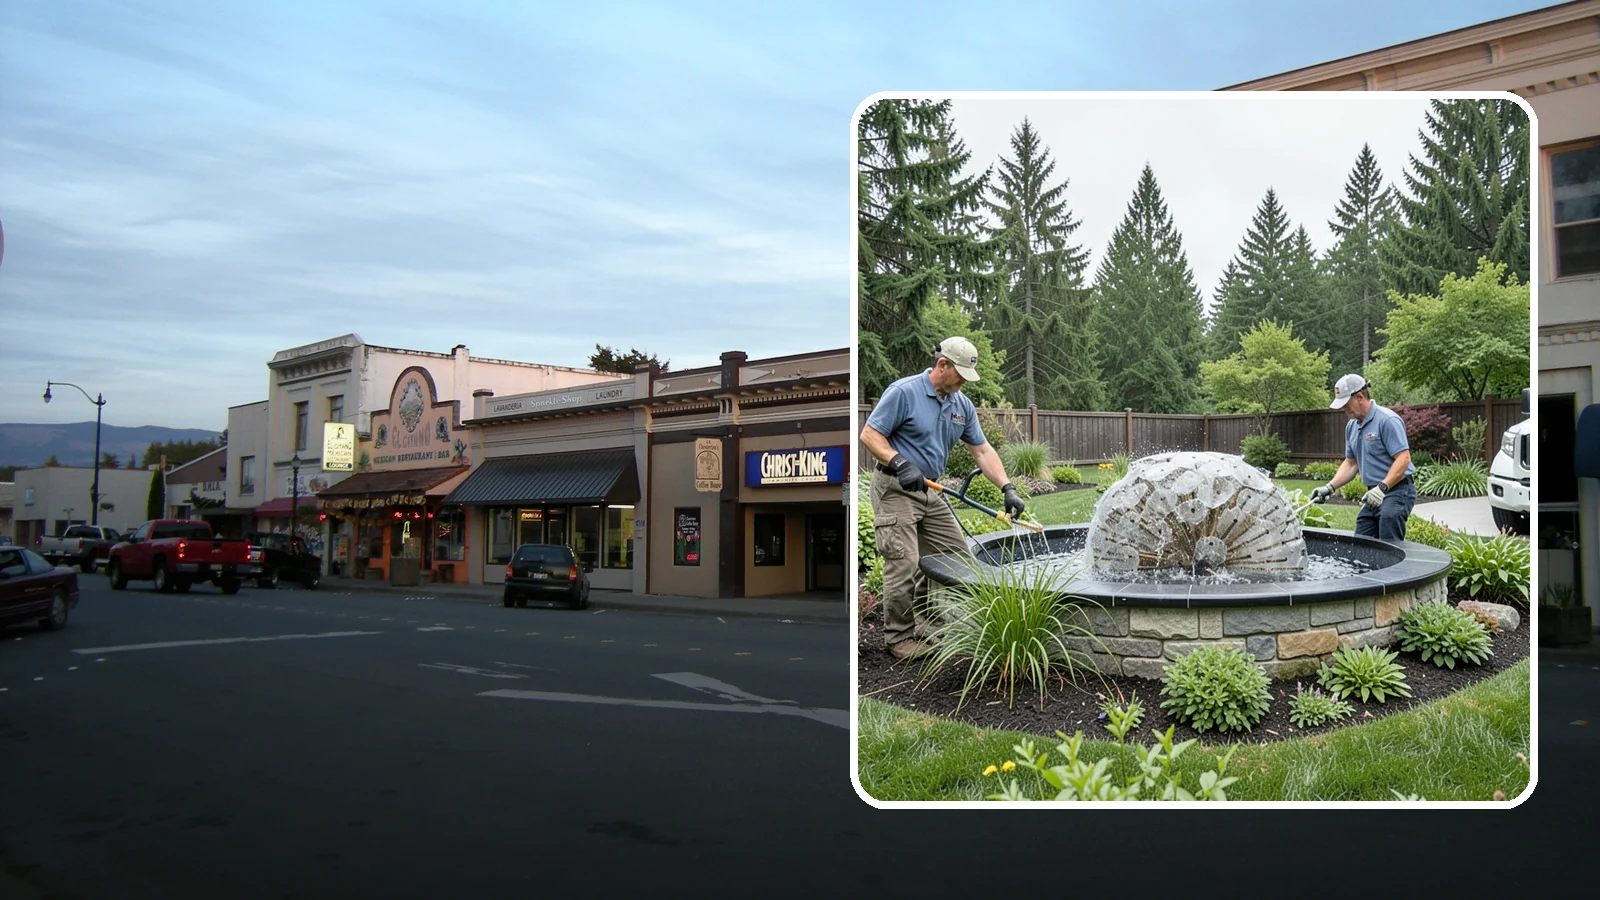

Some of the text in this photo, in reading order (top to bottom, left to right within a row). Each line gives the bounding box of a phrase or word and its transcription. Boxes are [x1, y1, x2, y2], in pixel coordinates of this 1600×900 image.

[493, 402, 522, 412] LAVANDERIA
[562, 394, 582, 405] Shop
[595, 389, 623, 400] LAUNDRY
[373, 450, 450, 464] MEXICAN RESTAURANT BAR
[761, 450, 827, 478] CHRIST KING
